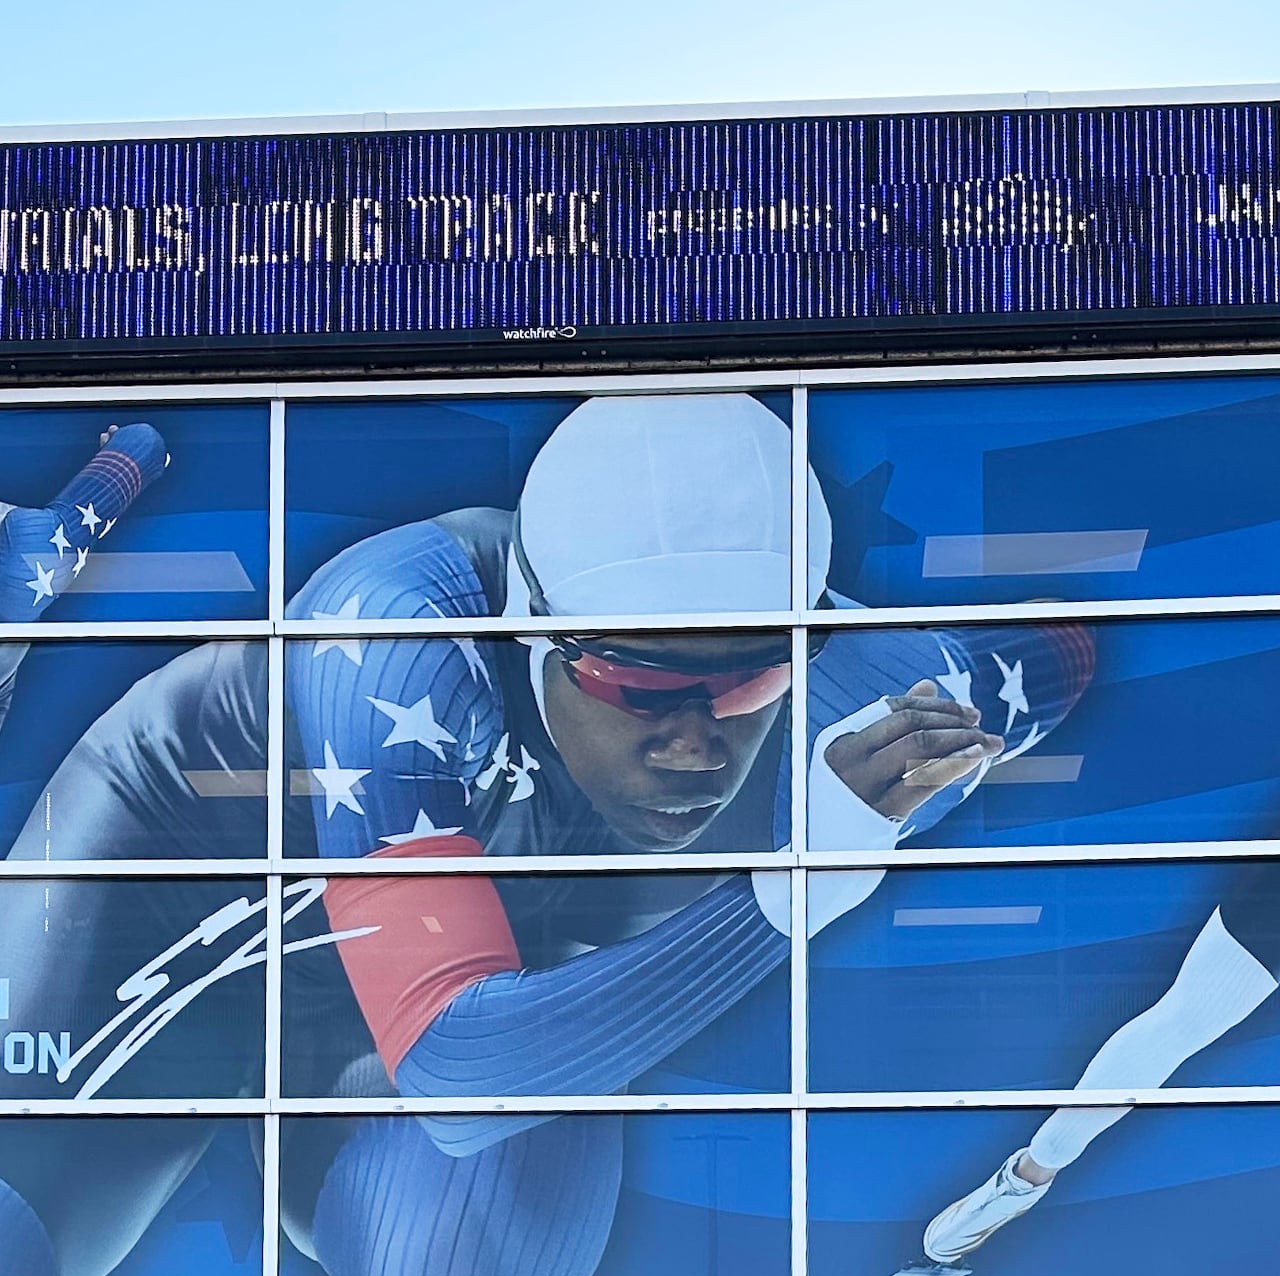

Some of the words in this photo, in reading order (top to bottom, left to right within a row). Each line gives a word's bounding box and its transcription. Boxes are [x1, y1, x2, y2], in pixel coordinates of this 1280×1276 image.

[231, 197, 383, 265] LONG
[408, 191, 600, 264] TRACK
[503, 327, 557, 340] watchfire
